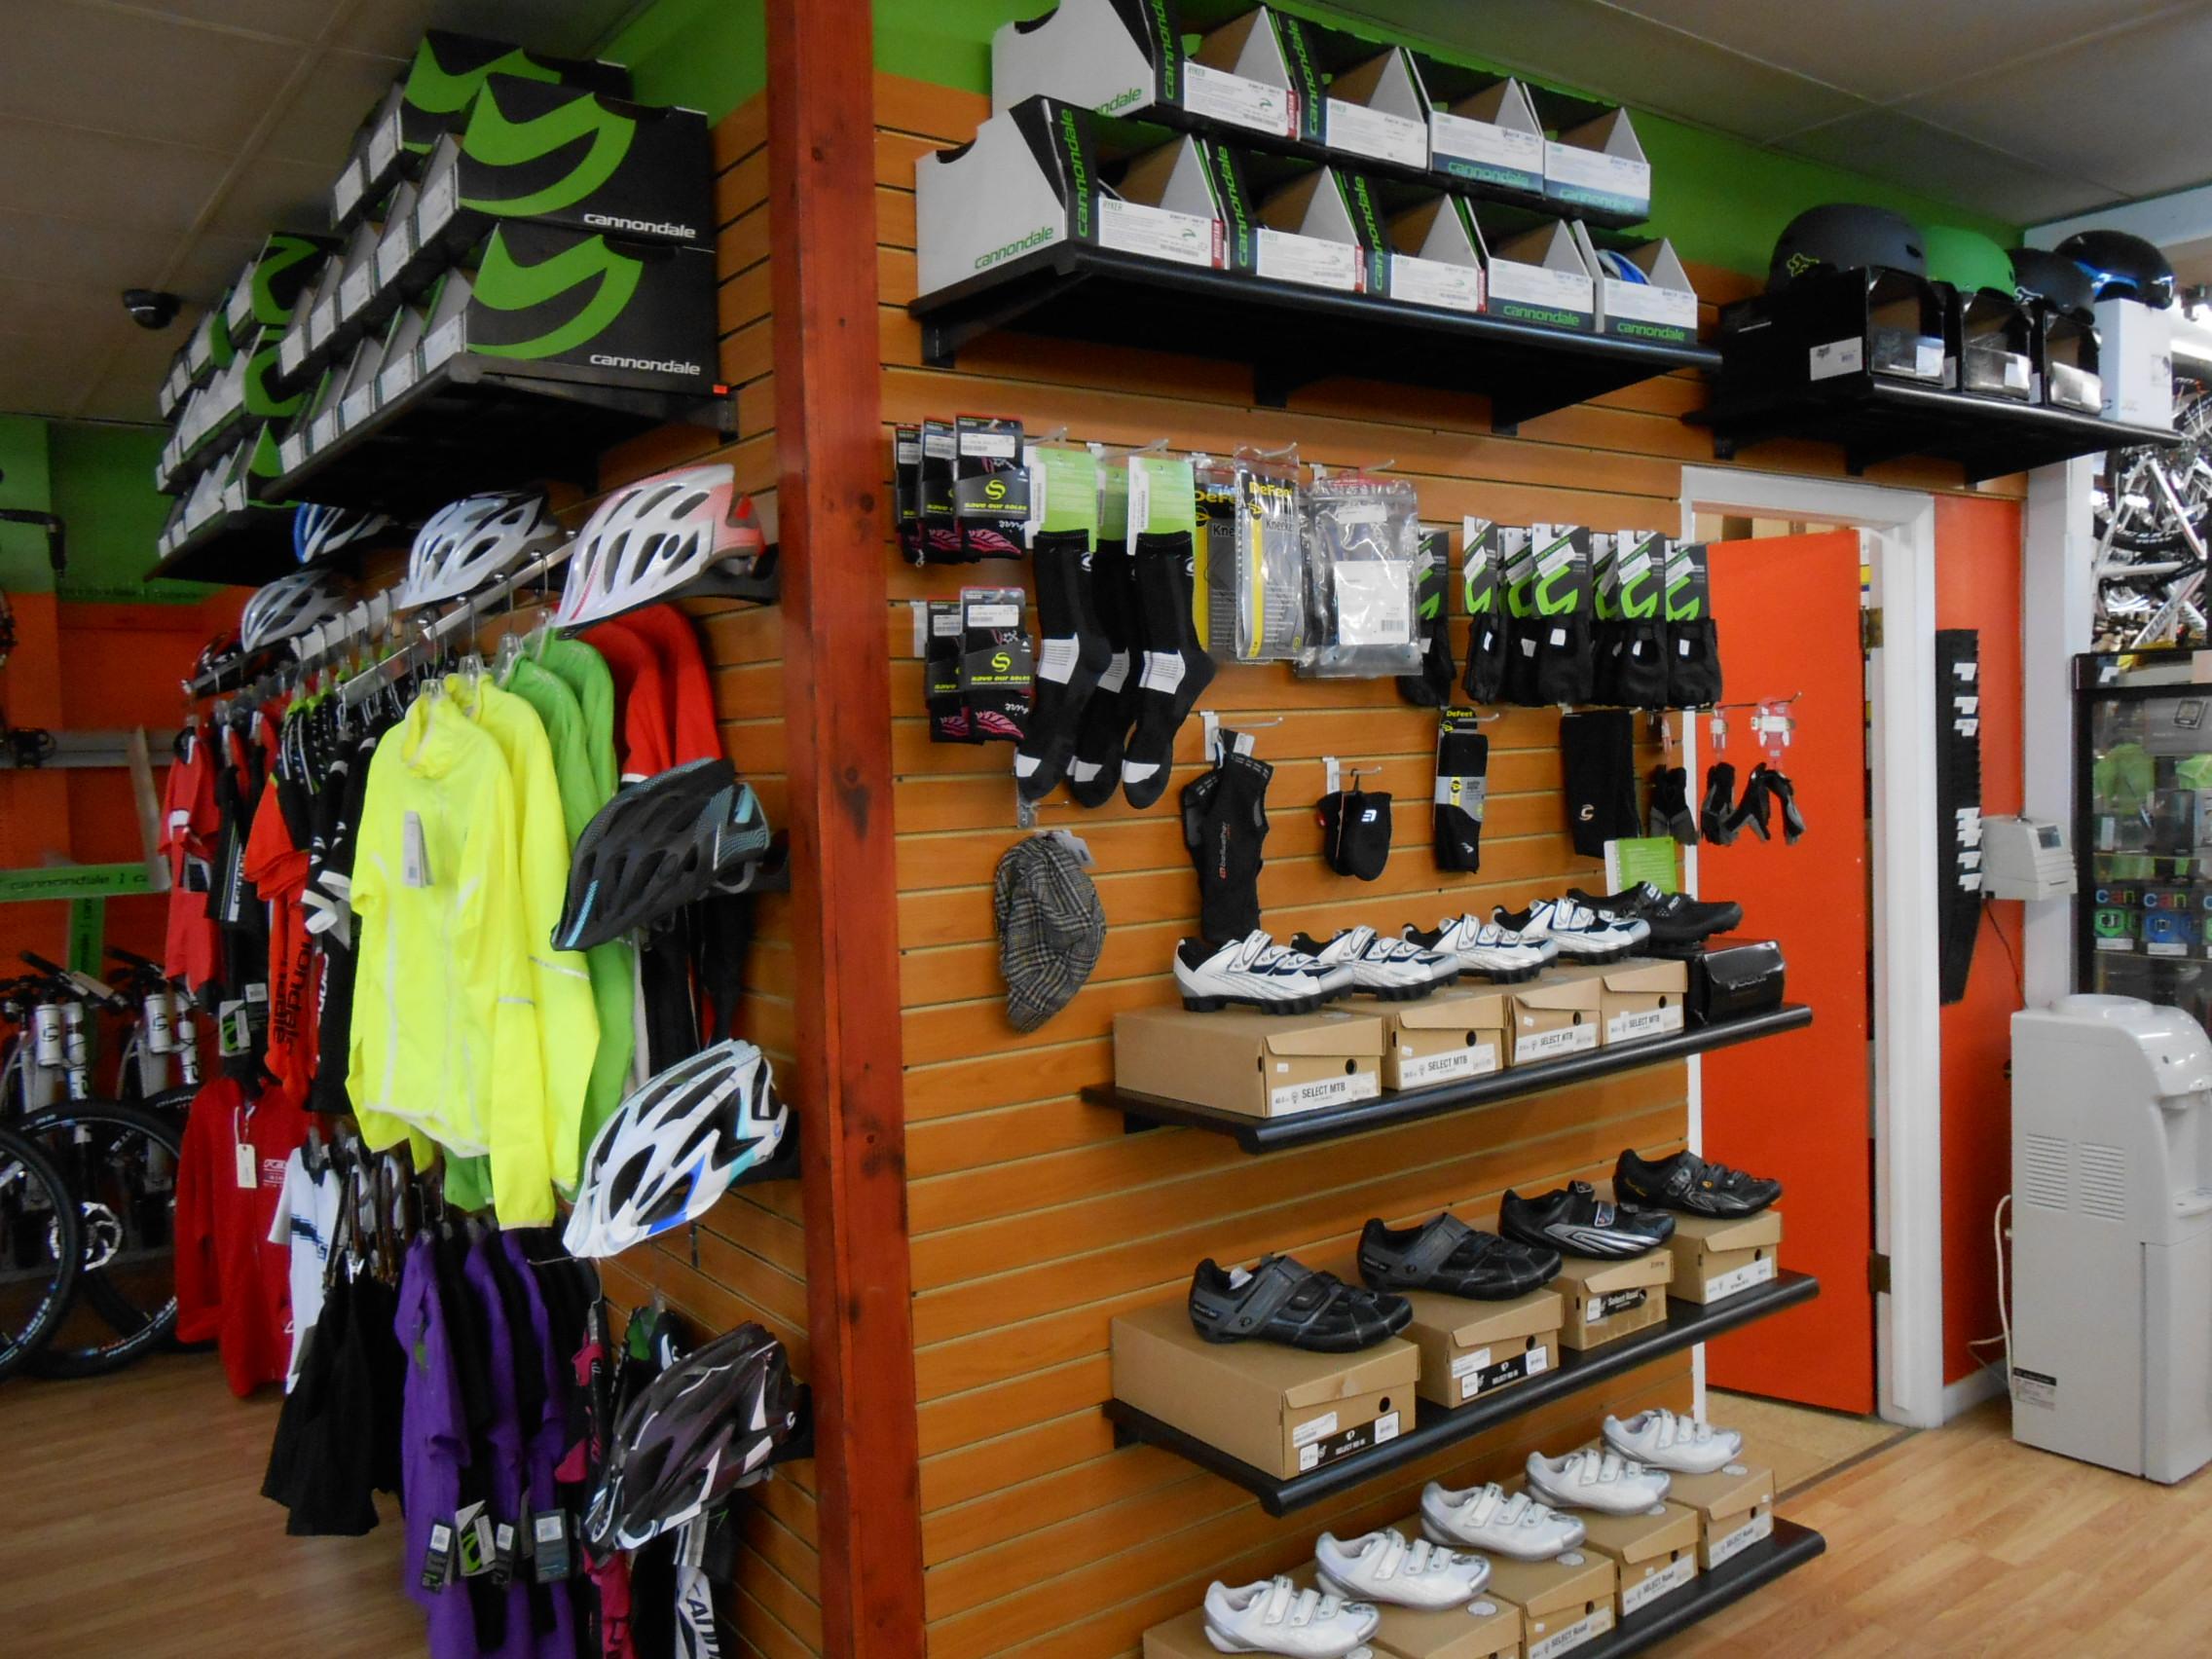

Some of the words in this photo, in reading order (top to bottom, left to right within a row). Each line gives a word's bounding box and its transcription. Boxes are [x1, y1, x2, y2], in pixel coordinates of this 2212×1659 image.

[1288, 19, 1319, 137] cannondale
[1059, 108, 1090, 239] cannondale
[1448, 161, 1530, 185] cannondale
[1218, 146, 1249, 268] cannondale
[1559, 188, 1637, 213] cannondale
[583, 212, 696, 239] cannondale
[1354, 175, 1383, 291] cannondale
[974, 225, 1054, 271] cannondale
[1502, 304, 1580, 328] cannondale
[1616, 321, 1686, 342] cannondale
[590, 353, 701, 376] cannondale
[1446, 710, 1473, 719] DeFeet
[1629, 1016, 1648, 1029] SELECT
[1539, 1034, 1561, 1047] SELECT
[1427, 1057, 1453, 1072] SELECT
[1453, 1054, 1468, 1069] MTB
[1302, 1084, 1328, 1099] SELECT
[1329, 1082, 1346, 1096] MTB
